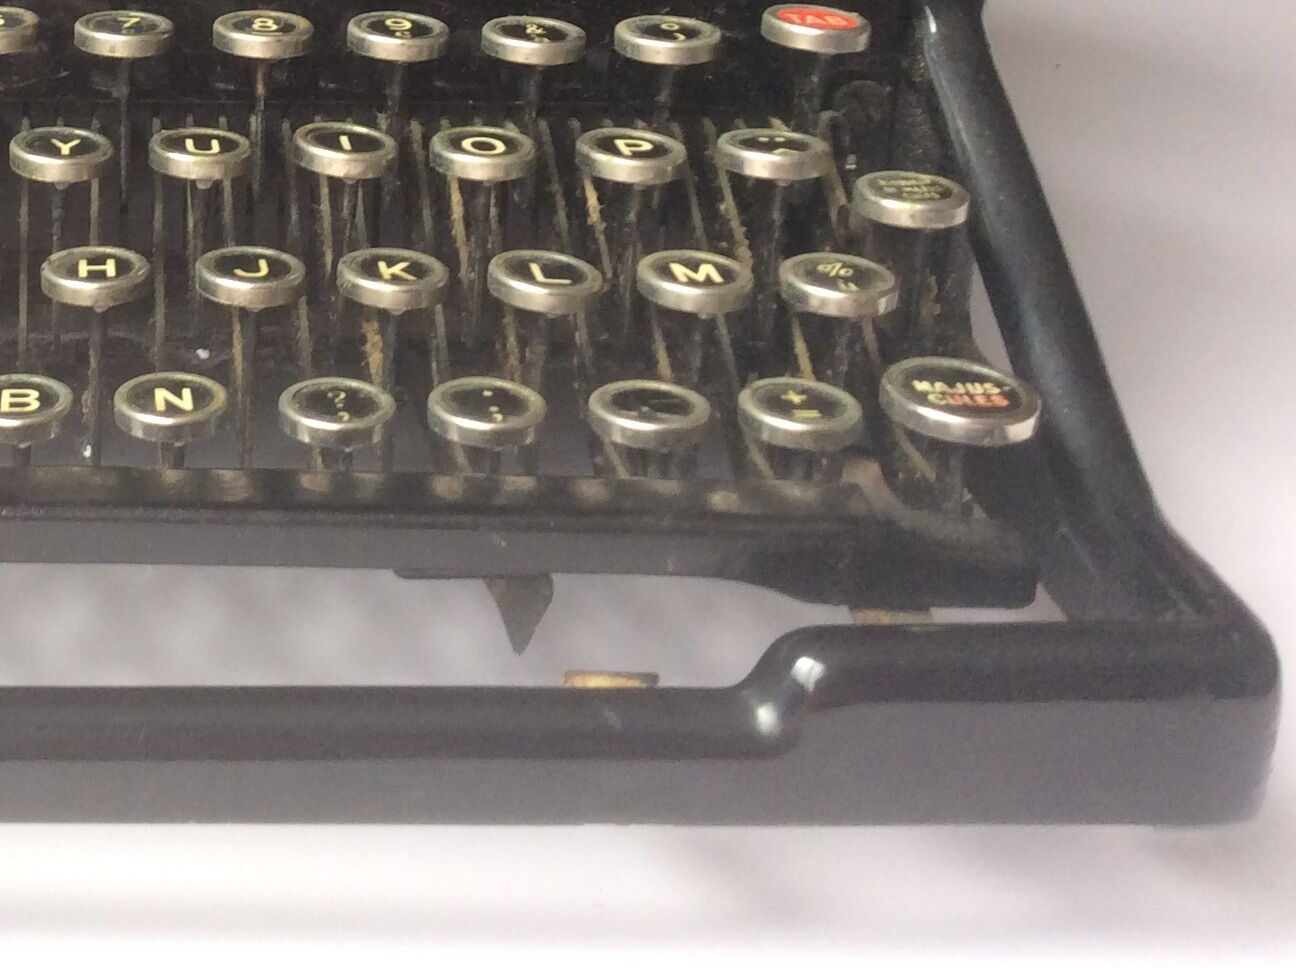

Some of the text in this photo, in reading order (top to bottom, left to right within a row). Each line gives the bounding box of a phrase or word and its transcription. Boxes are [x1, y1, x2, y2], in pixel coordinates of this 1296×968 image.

[117, 17, 141, 28] 7
[252, 17, 278, 31] 8
[385, 18, 412, 31] 9
[783, 13, 848, 27] TAB
[51, 138, 81, 156] Y
[184, 138, 221, 154] U
[460, 136, 506, 155] O
[613, 138, 653, 156] P
[77, 258, 117, 278] H
[233, 258, 270, 278] J
[377, 260, 419, 281] K
[528, 262, 573, 285] L
[668, 262, 724, 284] M
[0, 388, 41, 413] B
[153, 387, 193, 412] N
[927, 392, 1009, 409] CULES
